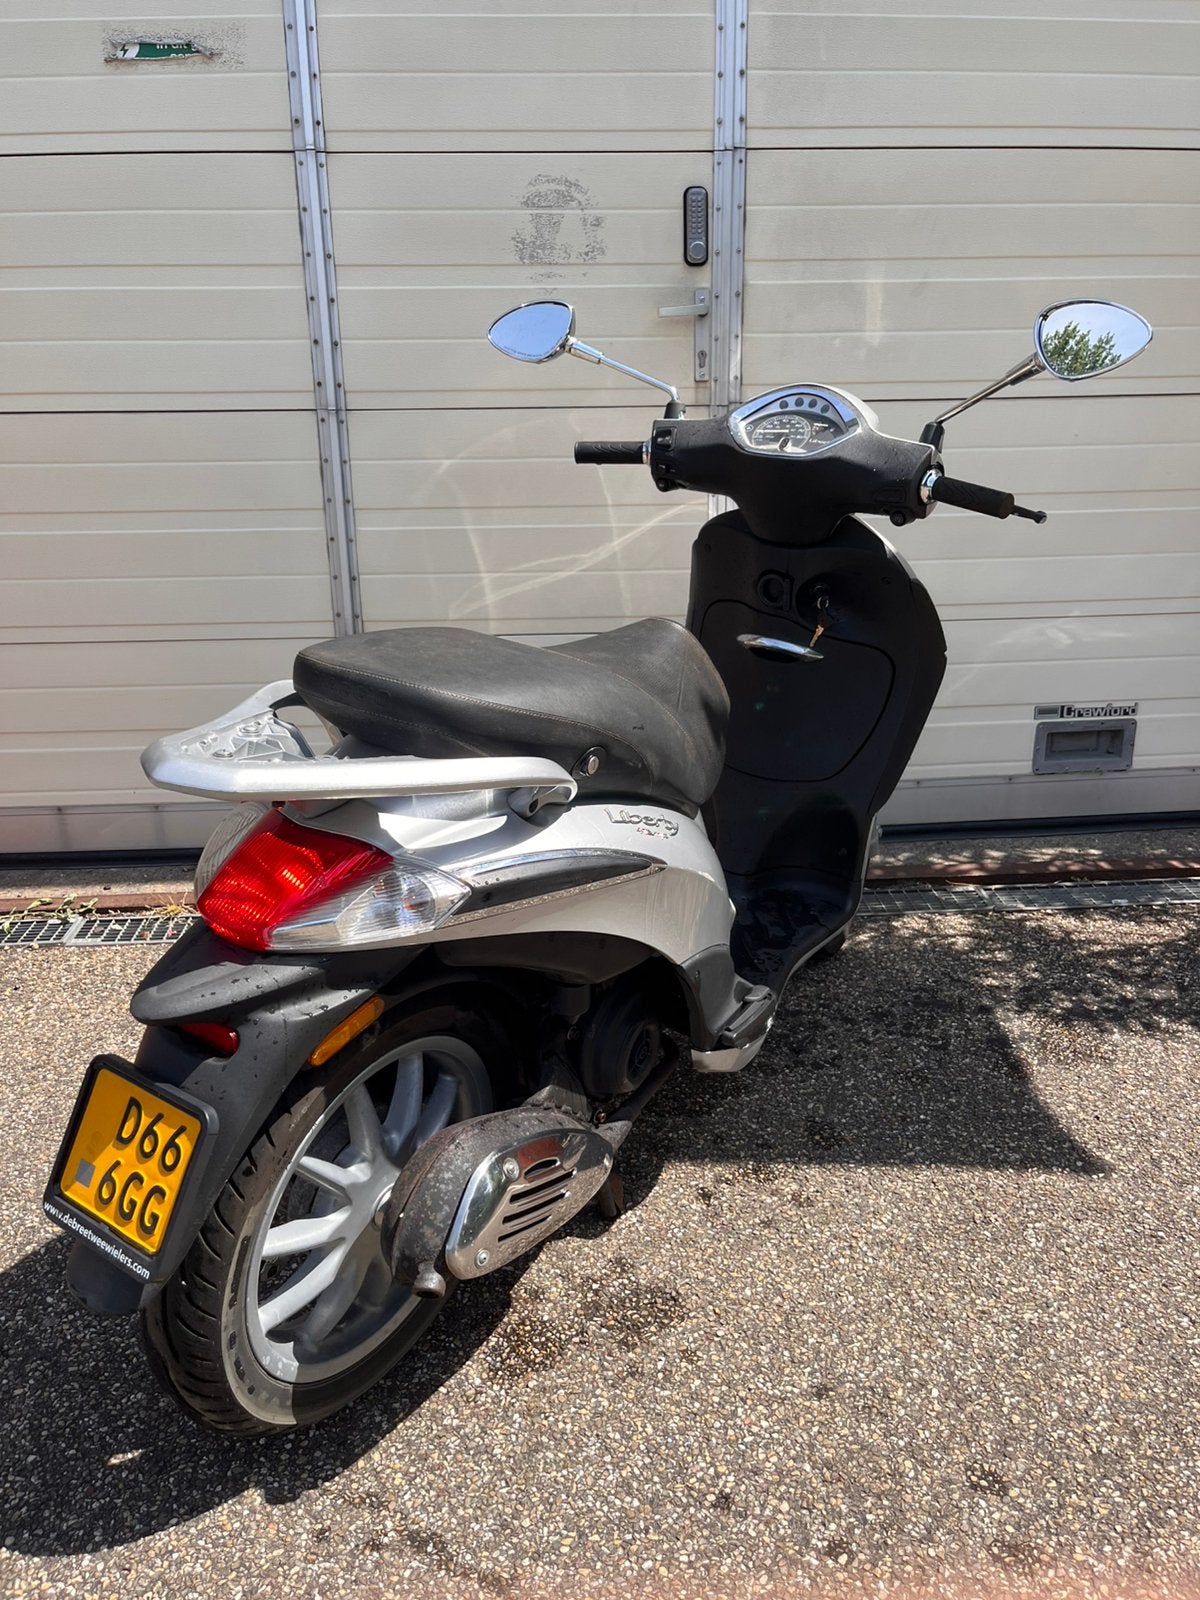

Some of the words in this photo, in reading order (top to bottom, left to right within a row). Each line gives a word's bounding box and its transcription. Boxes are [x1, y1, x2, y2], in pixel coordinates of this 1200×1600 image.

[1062, 702, 1139, 718] Crawford
[604, 808, 679, 836] Liberty
[115, 1096, 187, 1172] D66
[98, 1160, 167, 1235] 6GG
[43, 1201, 151, 1280] www.debreetweewielers.com
